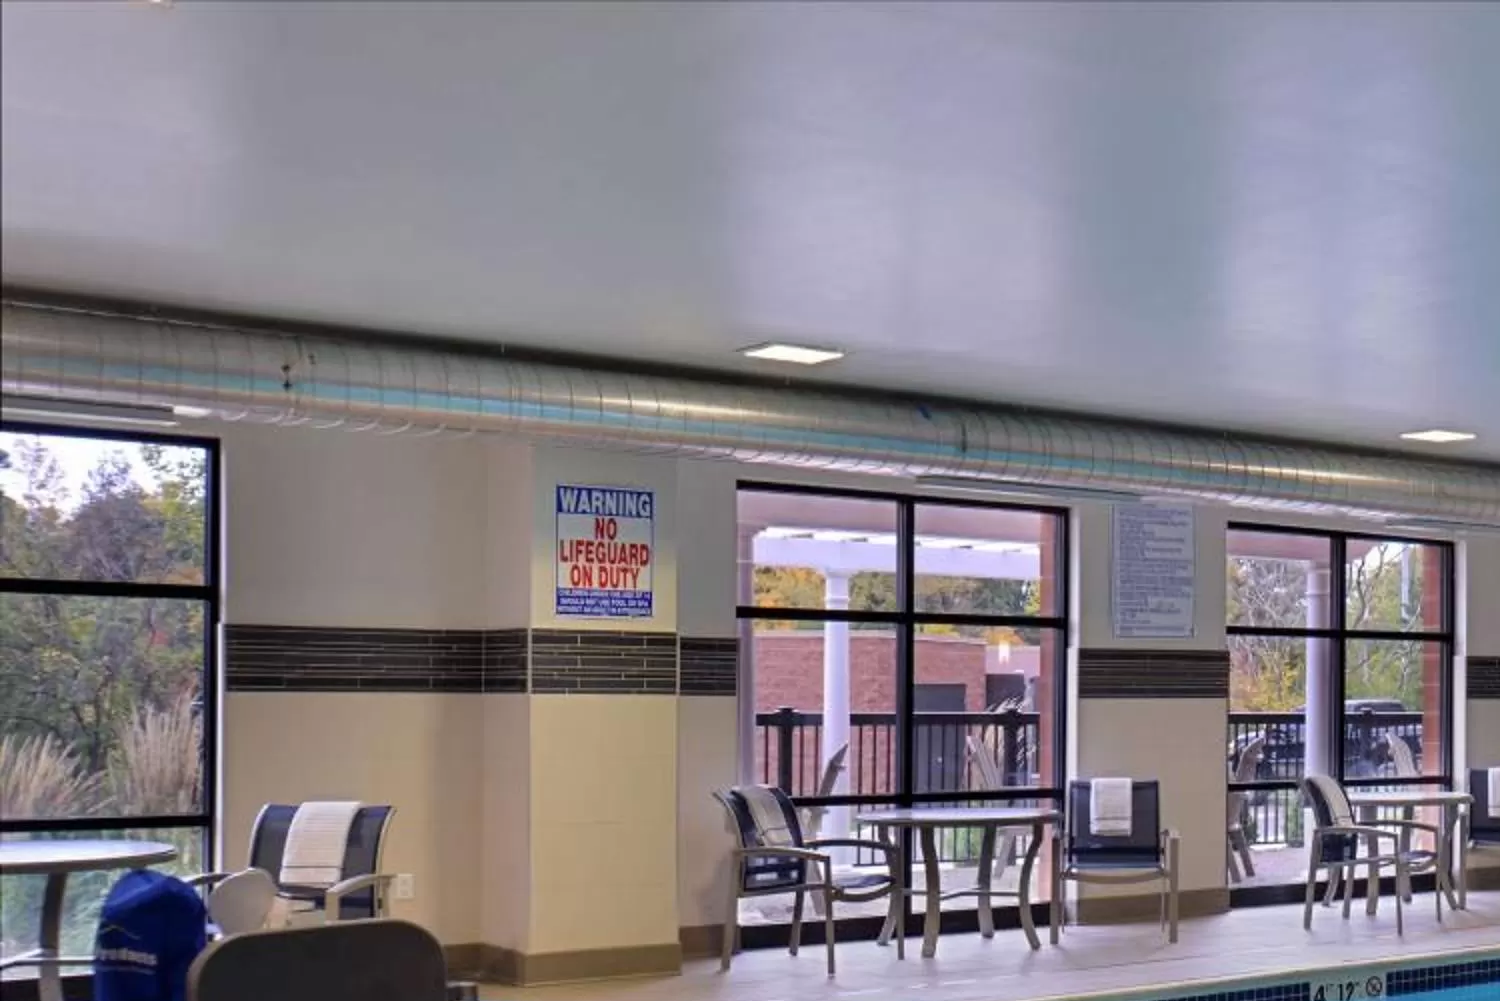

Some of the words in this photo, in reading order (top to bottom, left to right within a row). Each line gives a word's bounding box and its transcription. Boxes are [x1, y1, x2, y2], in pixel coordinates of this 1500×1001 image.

[560, 487, 651, 518] WARNING
[594, 517, 617, 540] NO
[560, 539, 650, 567] LIFEGUARD
[570, 564, 593, 587] ON
[598, 566, 641, 589] DUTY
